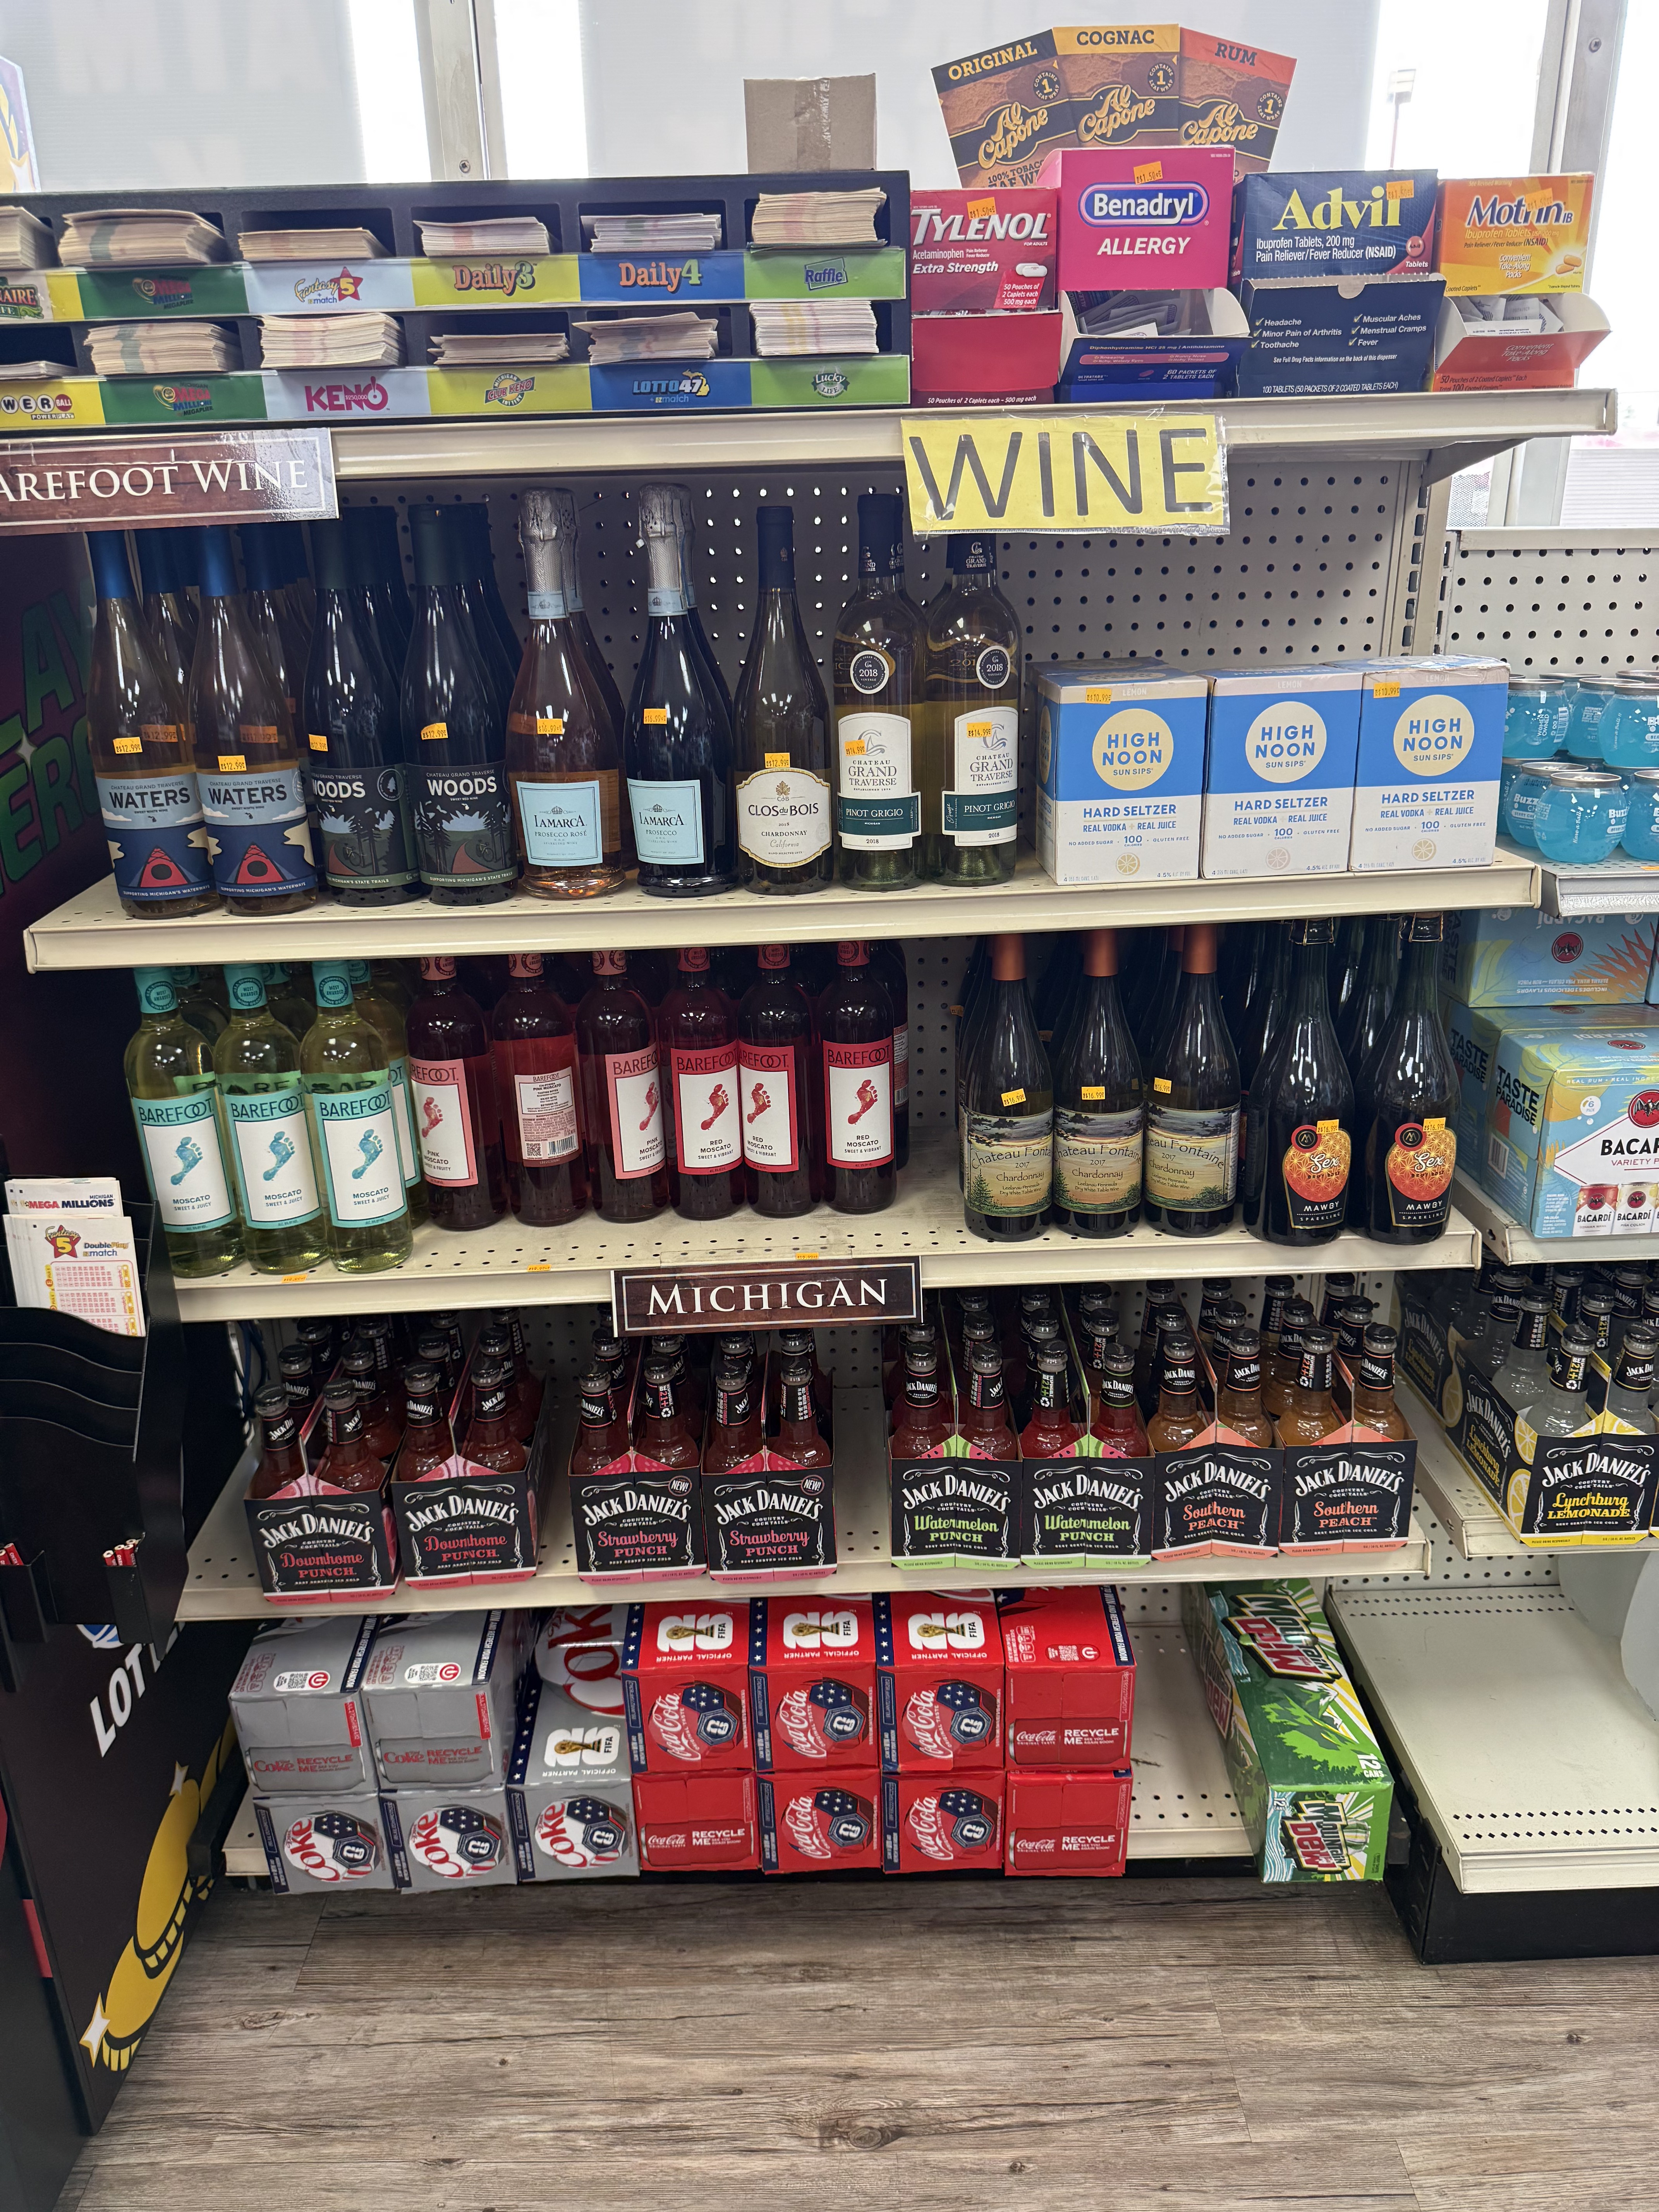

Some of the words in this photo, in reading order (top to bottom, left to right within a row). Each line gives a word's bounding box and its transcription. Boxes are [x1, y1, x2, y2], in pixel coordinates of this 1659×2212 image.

[1077, 30, 1154, 45] COGNAC
[948, 41, 1037, 80] ORIGINAL
[1215, 43, 1257, 66] RUM
[1100, 84, 1131, 110] Al
[994, 103, 1023, 139] Al
[1079, 98, 1155, 141] Capone
[978, 108, 1048, 169] Capone
[1094, 192, 1193, 225] Benadryl
[1272, 186, 1401, 230] Advil
[1563, 213, 1573, 223] IB
[911, 209, 1048, 246] TYLENOL
[1465, 229, 1503, 240] Ibuprofen
[1505, 228, 1531, 237] Tablets
[1097, 237, 1190, 255] ALLERGY
[1257, 238, 1292, 251] Ibuprofen
[1295, 236, 1324, 249] Tablets,
[1326, 236, 1340, 246] 200
[1343, 237, 1354, 248] mg
[1524, 238, 1548, 247] (NSAID)
[913, 249, 963, 259] Acetaminophen
[1256, 251, 1273, 262] Pain
[1274, 249, 1330, 261] Reliever/Fever
[1333, 247, 1364, 259] Reducer
[1365, 246, 1396, 259] (NSAID)
[805, 268, 843, 283] Raffle
[913, 264, 944, 274] Extra
[947, 261, 998, 273] Strength
[295, 278, 338, 303] Fantasy
[339, 278, 355, 295] 5
[816, 373, 845, 384] Lucky
[175, 387, 211, 401] MEGA
[306, 376, 388, 411] KENO
[488, 389, 507, 400] CLUB
[509, 380, 532, 393] KENO
[193, 460, 308, 493] WINE
[909, 428, 1212, 520] WINE
[859, 669, 878, 677] 2018
[1410, 718, 1461, 734] HIGH
[1108, 732, 1159, 748] HIGH
[1403, 735, 1462, 751] NOON
[1102, 750, 1162, 765] NOON
[848, 766, 897, 777] GRAND
[427, 776, 496, 796] WOODS
[109, 788, 190, 809] WATERS
[1382, 793, 1419, 804] HARD
[1422, 790, 1474, 801] SELTZER
[748, 804, 778, 816] CLOS
[779, 807, 788, 815] du
[790, 803, 819, 815] BOIS
[846, 809, 869, 817] PINOT
[871, 809, 903, 817] GRIGIO
[1084, 807, 1120, 818] HARD
[1123, 804, 1176, 816] SELTZER
[1083, 824, 1101, 832] REAL
[1103, 823, 1126, 831] VODKA
[827, 1045, 890, 1063] BAREFOOT
[1497, 1065, 1540, 1113] TASTE
[139, 1097, 212, 1122] BAREFOOT
[320, 1091, 392, 1117] BAREFOOT
[1496, 1087, 1537, 1126] PARADISE
[971, 1148, 1020, 1169] Chateau
[1310, 1154, 1340, 1173] Sex
[1611, 1158, 1651, 1166] VARIETY
[996, 1171, 1044, 1182] Chardonnay
[173, 1195, 210, 1205] MOSCATO
[353, 1188, 389, 1199] MOSCATO
[62, 1199, 114, 1208] MILLIONS
[1304, 1201, 1339, 1211] MAWBY
[1577, 1211, 1612, 1223] BACARDÍ
[647, 1279, 888, 1315] MICHIGAN
[1542, 1458, 1583, 1487] JACK
[671, 1480, 689, 1491] NEW!
[1295, 1468, 1336, 1496] JACK
[902, 1481, 942, 1510] JACK
[1553, 1492, 1629, 1511] Lynchburg
[582, 1498, 622, 1526] JACK
[1314, 1501, 1379, 1516] Southern
[1547, 1508, 1630, 1519] LEMONADE
[914, 1515, 999, 1533] Watermelon
[1319, 1517, 1372, 1528] PEACH
[598, 1532, 678, 1548] Strawberry
[929, 1533, 983, 1543] PUNCH
[615, 1546, 666, 1557] PUNCH
[280, 1553, 364, 1568] Downhome
[298, 1568, 356, 1577] PUNCH
[1064, 1728, 1119, 1737] RECYCLE
[297, 1753, 352, 1765] RECYCLE
[1357, 1753, 1382, 1769] 12
